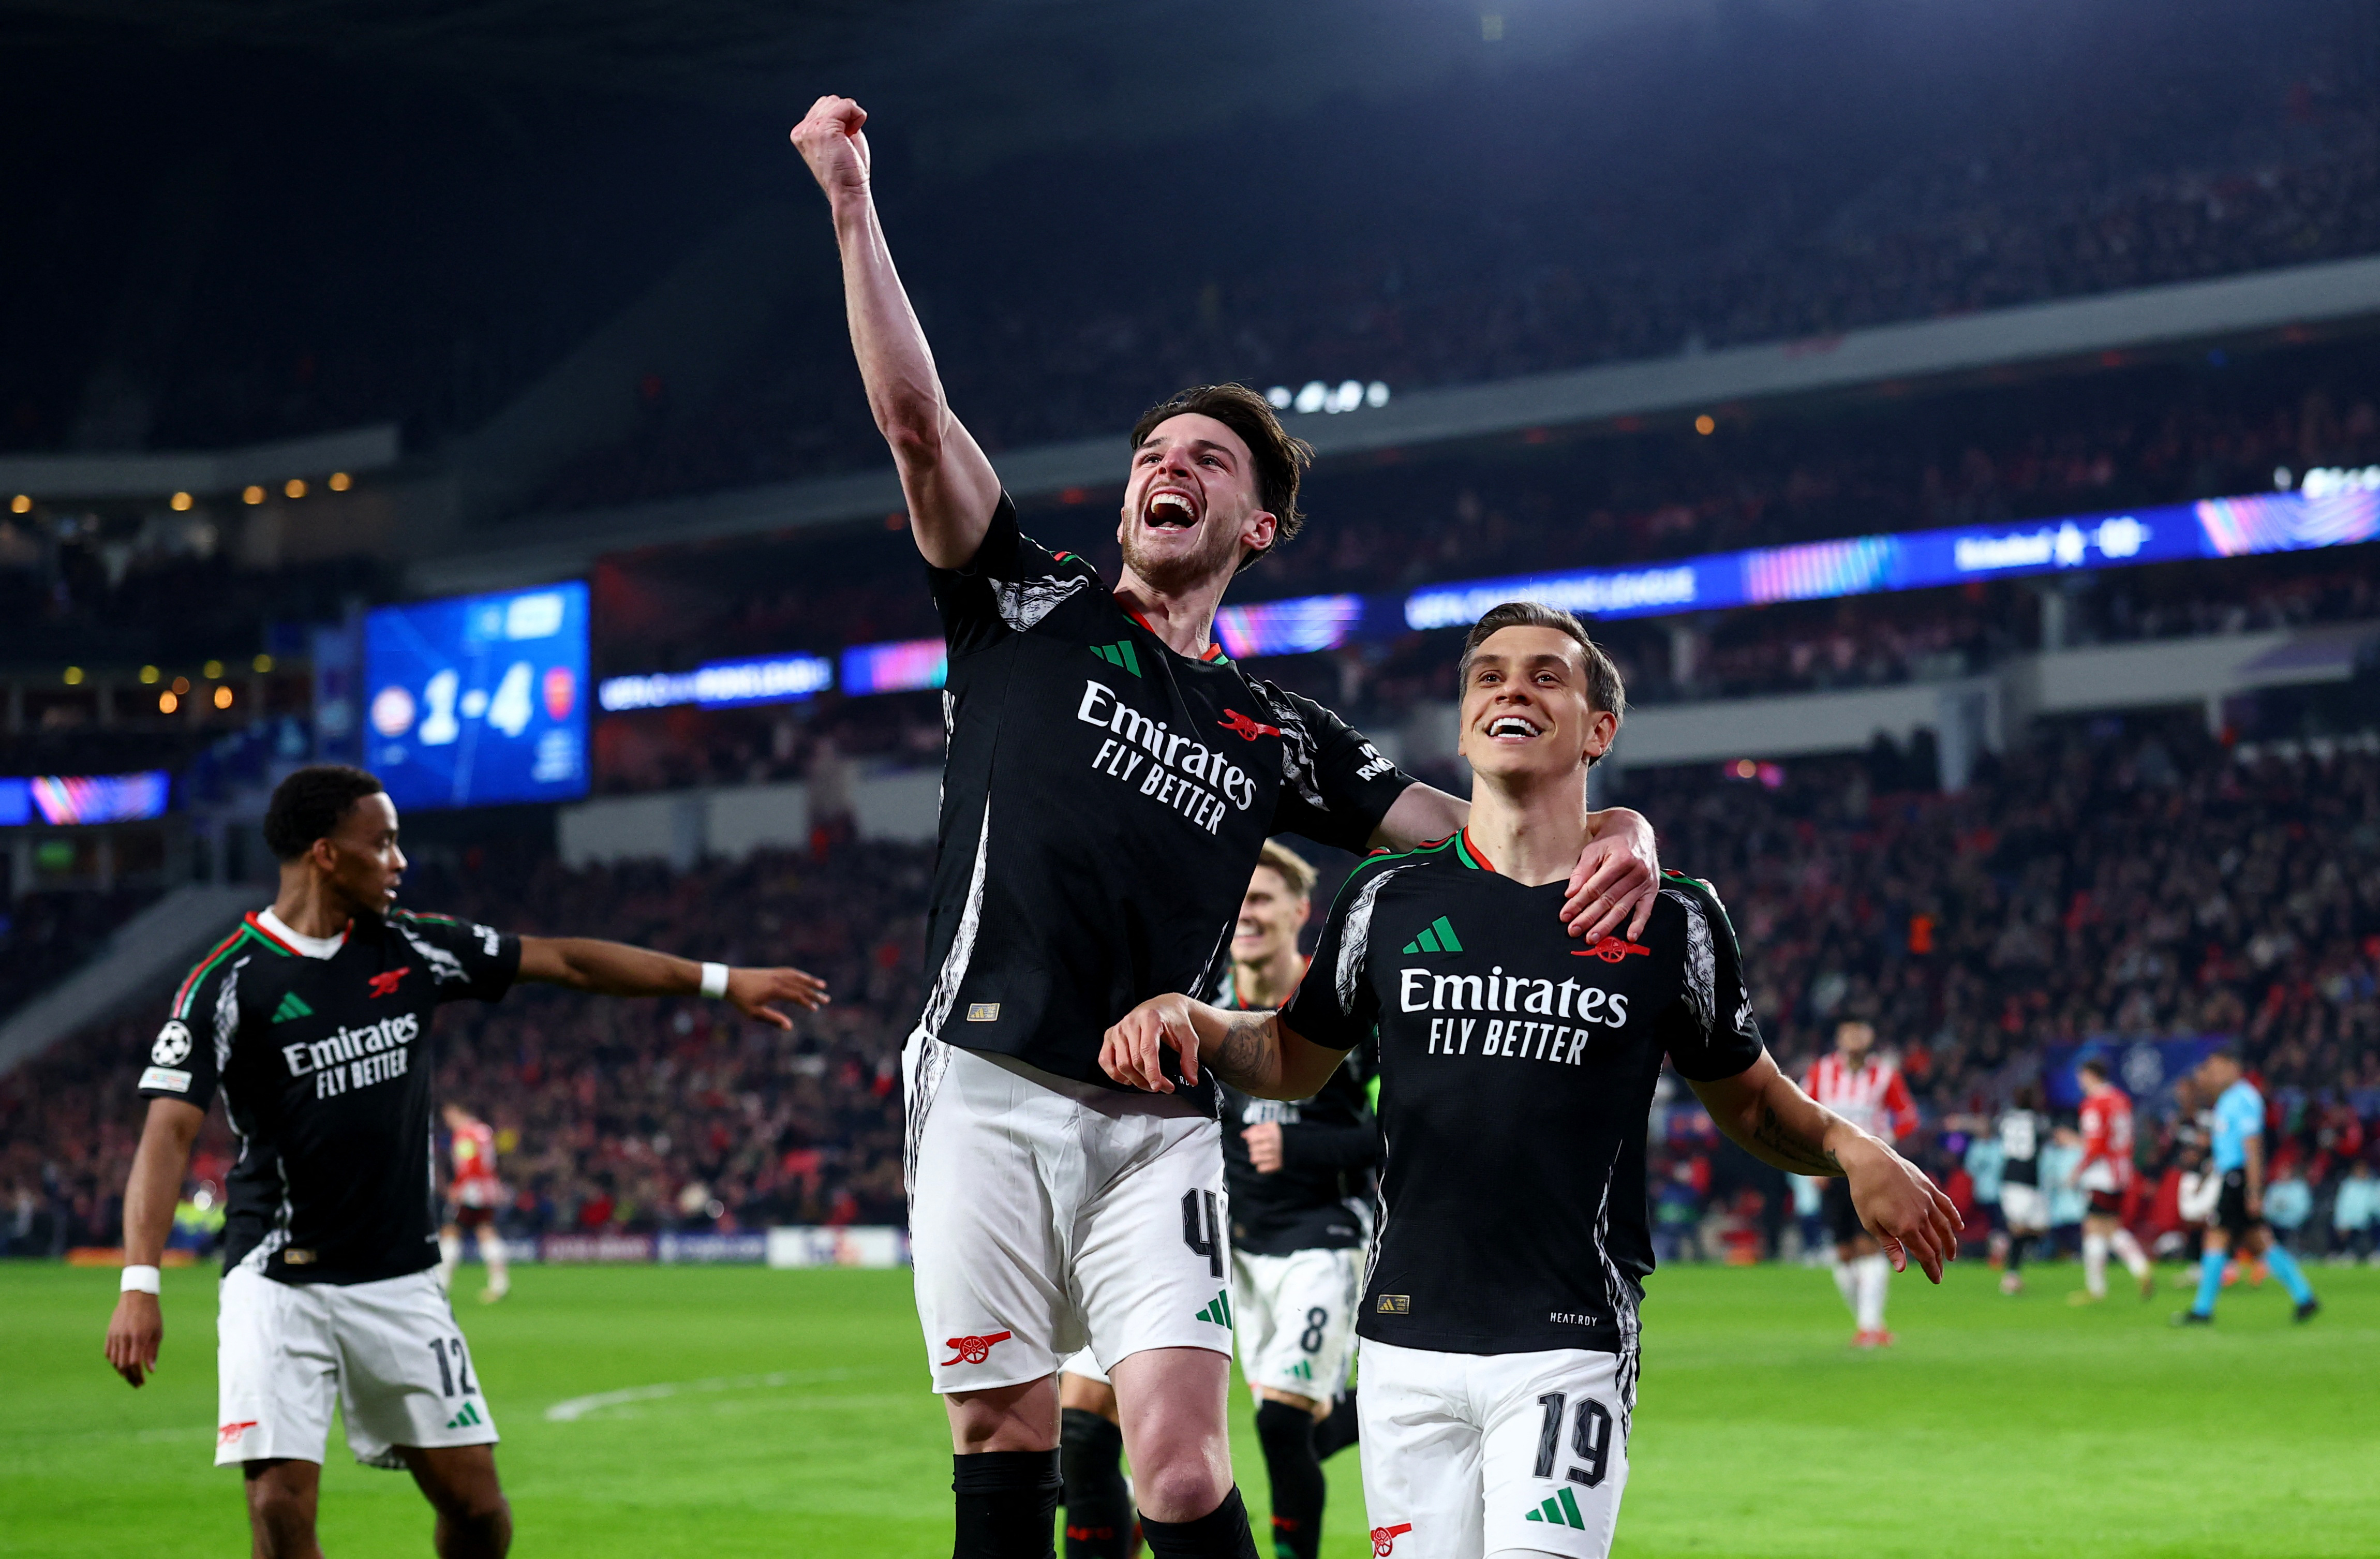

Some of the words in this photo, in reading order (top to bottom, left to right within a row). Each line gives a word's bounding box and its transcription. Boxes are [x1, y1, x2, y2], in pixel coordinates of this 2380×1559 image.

[1077, 679, 1257, 810] Emirates
[1092, 738, 1144, 781] FLY
[1139, 763, 1226, 836] BETTER
[1400, 966, 1629, 1028] Emirates
[281, 1012, 420, 1077] Emirates
[1428, 1018, 1477, 1055] FLY
[1482, 1019, 1589, 1066] BETTER
[316, 1065, 347, 1100] FLY
[350, 1047, 408, 1089] BETTER
[1181, 1187, 1233, 1284] 4
[1300, 1306, 1329, 1356] 8
[1550, 1312, 1598, 1327] HEAT.RDY
[428, 1337, 476, 1398] 12
[1532, 1391, 1613, 1490] 19
